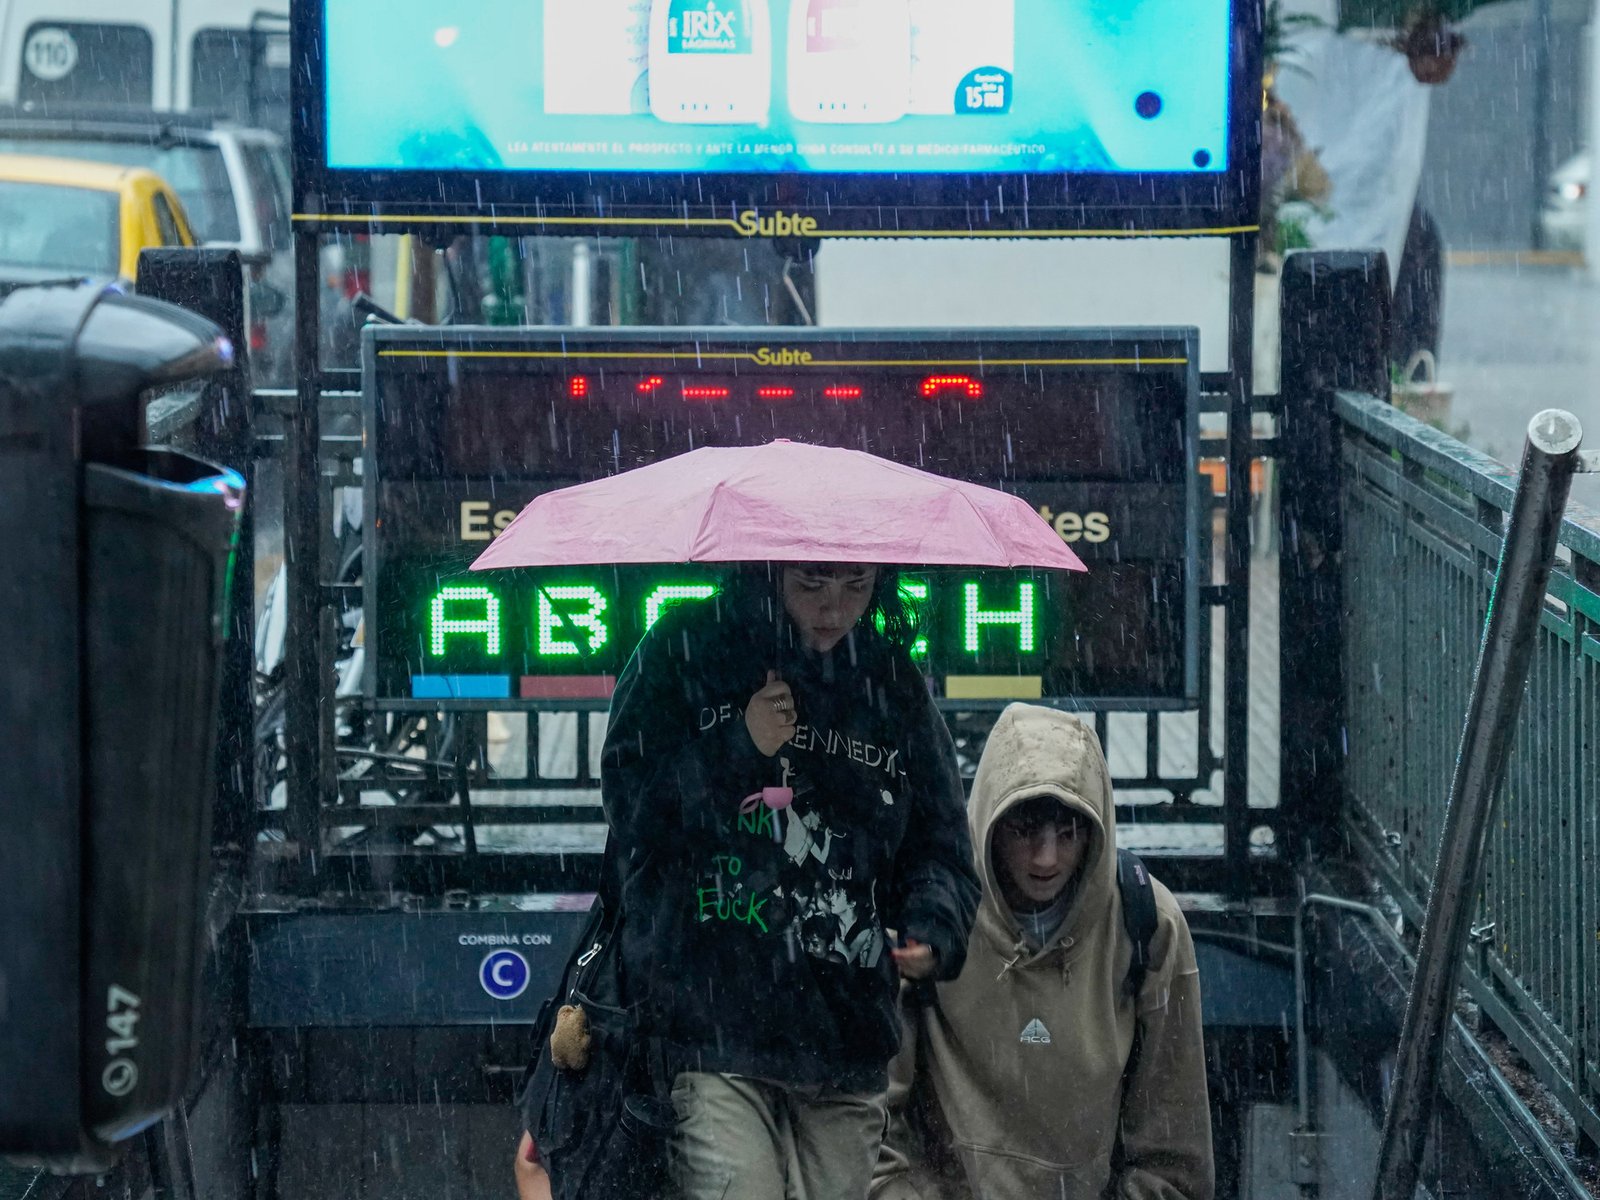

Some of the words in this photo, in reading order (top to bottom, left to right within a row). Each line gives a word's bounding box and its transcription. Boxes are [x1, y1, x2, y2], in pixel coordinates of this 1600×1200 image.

[34, 42, 68, 67] 110
[706, 143, 733, 154] ANTE
[737, 143, 751, 154] LA
[741, 211, 817, 236] Subte
[757, 348, 812, 365] Subte
[461, 502, 526, 540] Es
[1040, 505, 1110, 543] tes
[431, 587, 500, 655] A
[539, 586, 607, 655] B
[965, 583, 1033, 651] H
[698, 888, 768, 933] FUCK
[459, 935, 519, 945] COMBINA
[522, 935, 552, 945] CON
[492, 960, 513, 987] C
[105, 983, 140, 1055] 147
